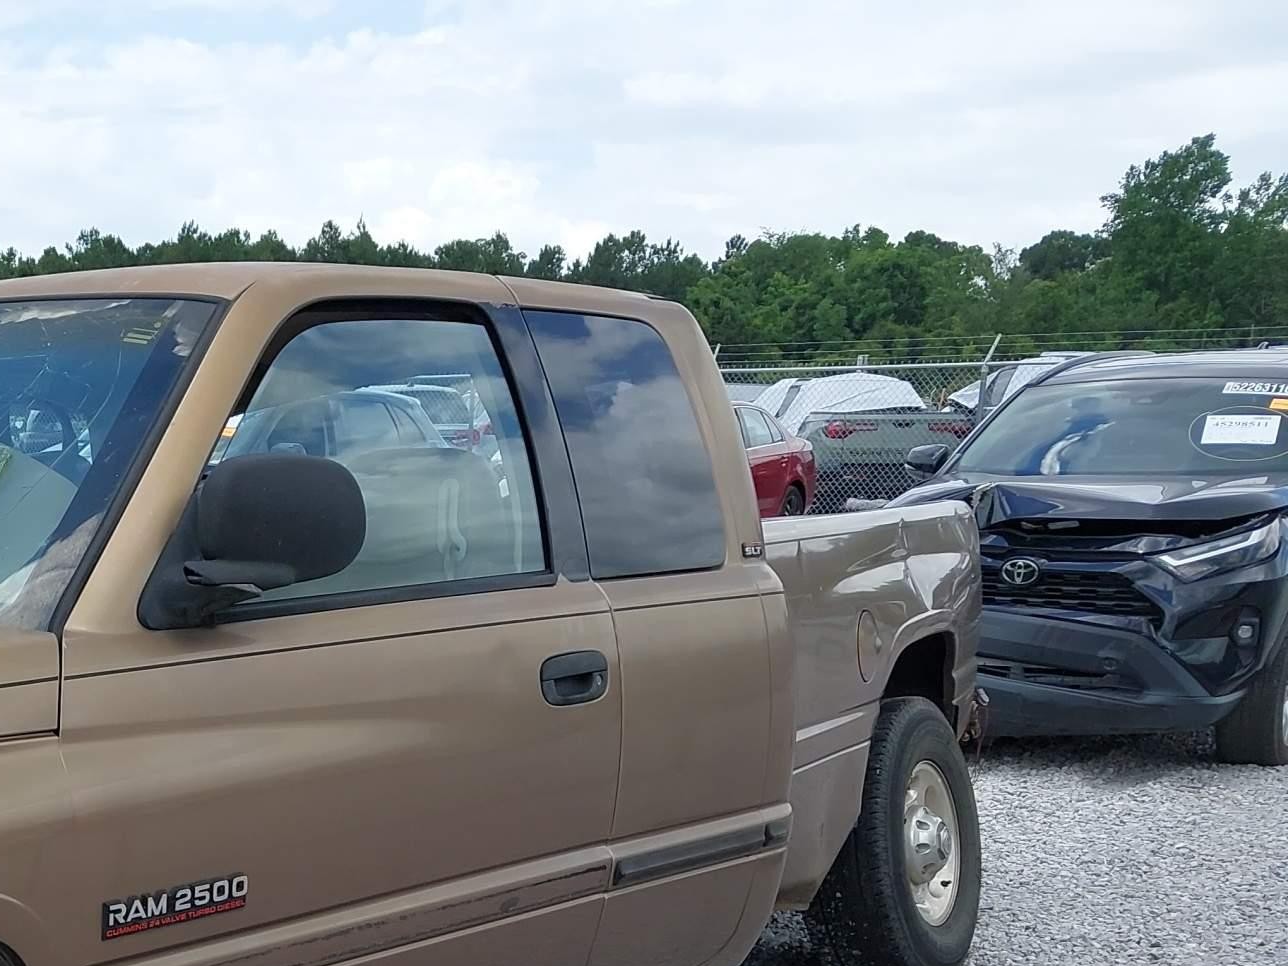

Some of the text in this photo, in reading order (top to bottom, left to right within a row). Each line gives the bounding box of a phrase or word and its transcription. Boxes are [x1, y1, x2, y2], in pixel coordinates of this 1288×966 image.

[744, 546, 762, 556] SLT
[105, 900, 246, 938] CUMMINS 24 VALVE TURBO DIESEL
[108, 875, 249, 926] RAM 2500
